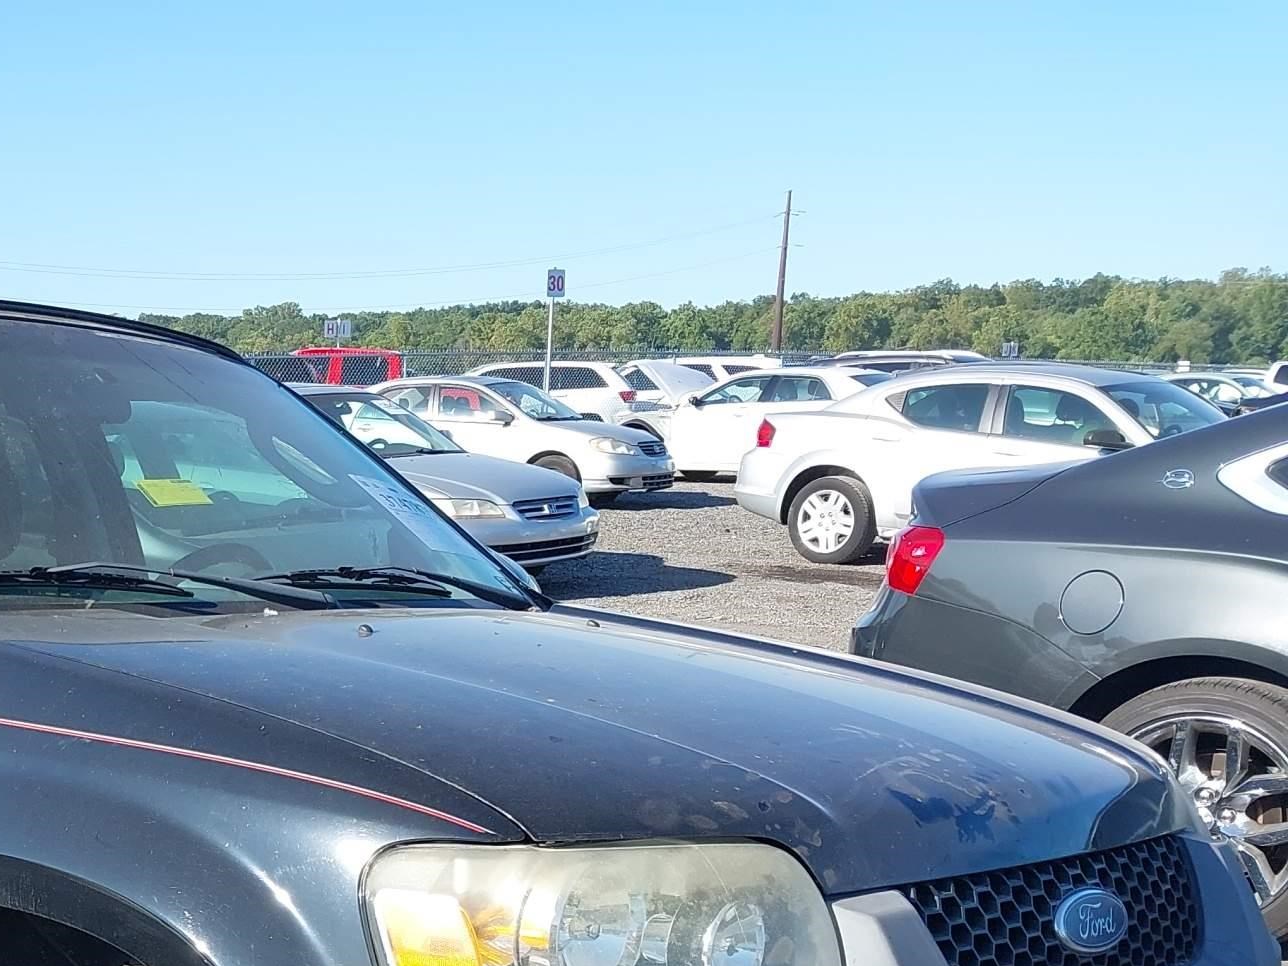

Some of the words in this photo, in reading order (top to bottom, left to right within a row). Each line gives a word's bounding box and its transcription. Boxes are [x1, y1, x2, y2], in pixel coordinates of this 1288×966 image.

[548, 275, 564, 291] 30
[327, 322, 335, 334] H
[1079, 902, 1117, 939] Ford
